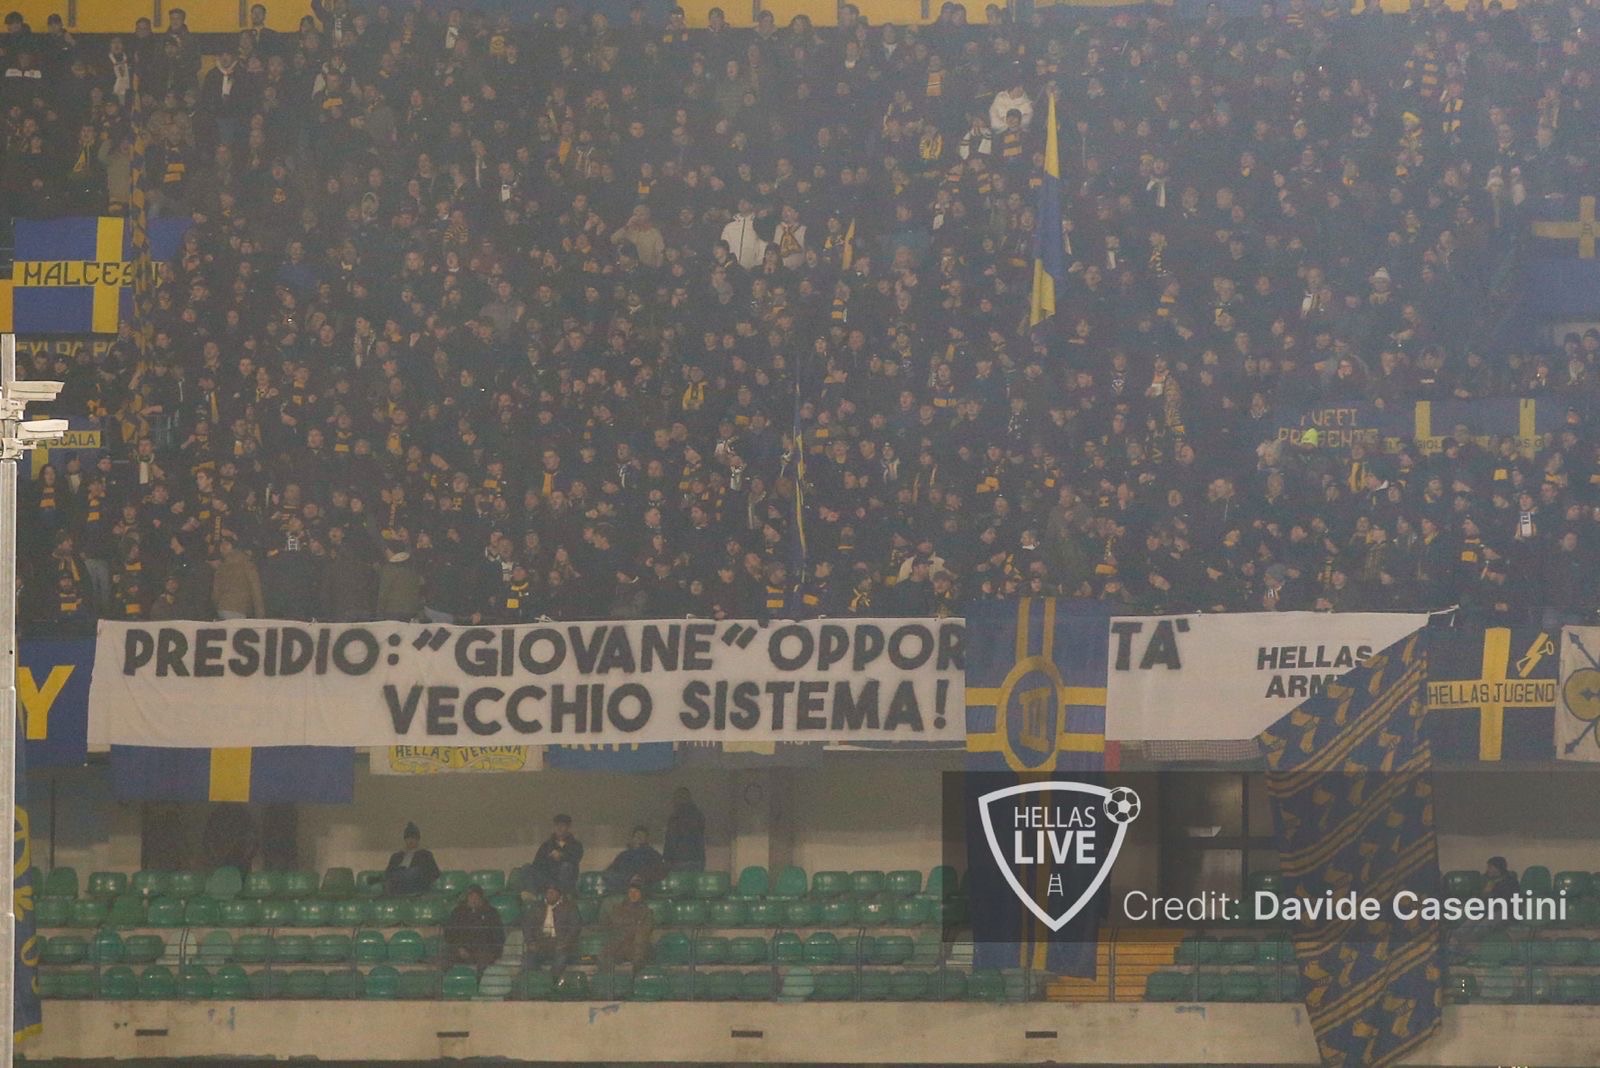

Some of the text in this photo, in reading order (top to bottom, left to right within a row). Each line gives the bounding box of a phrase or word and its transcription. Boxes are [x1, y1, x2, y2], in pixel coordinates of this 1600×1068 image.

[1257, 645, 1374, 670] HELLAS
[1265, 674, 1344, 698] ARM
[1428, 683, 1489, 705] HELLAS
[384, 679, 948, 736] VECCHIO SISTEMA!
[395, 745, 450, 763] HELLAS
